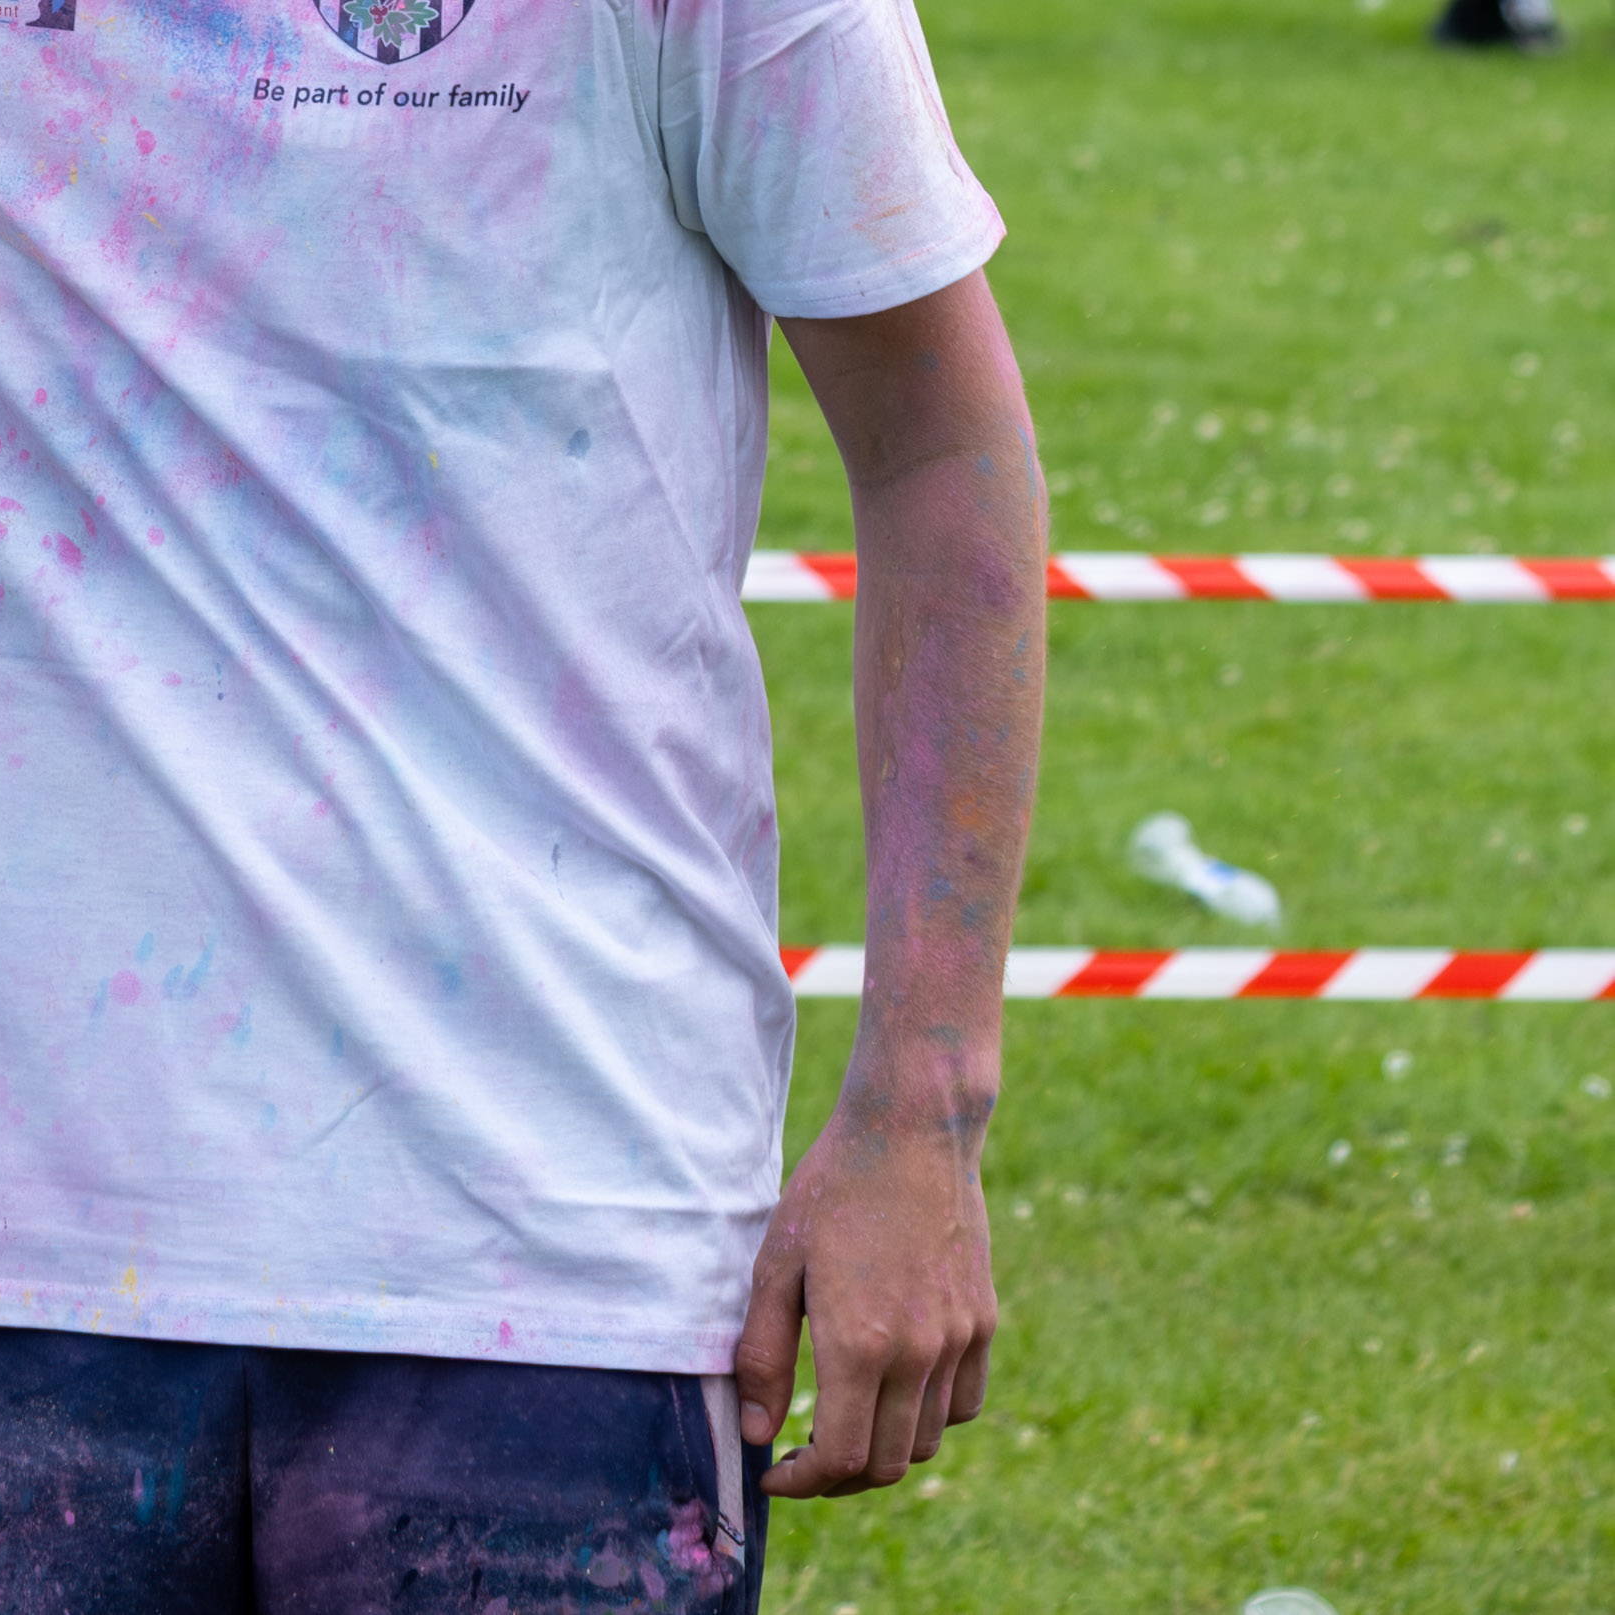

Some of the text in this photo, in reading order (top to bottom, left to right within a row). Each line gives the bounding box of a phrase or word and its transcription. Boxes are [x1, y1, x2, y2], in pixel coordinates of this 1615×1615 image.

[253, 78, 531, 113] Be part of our family
